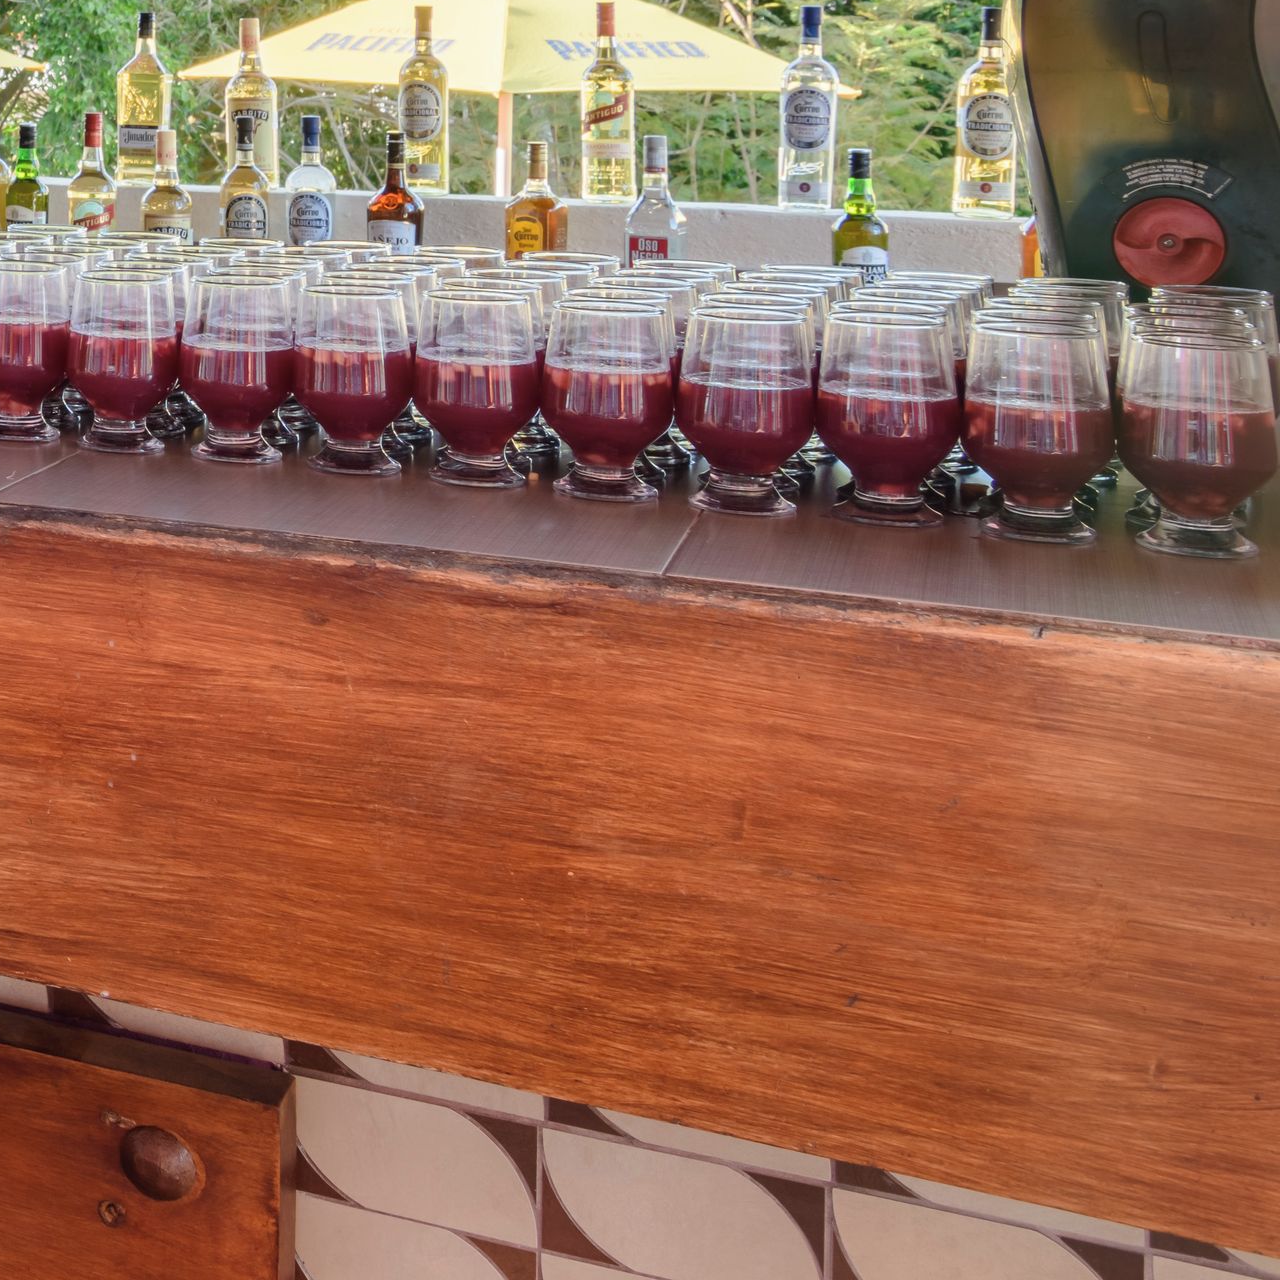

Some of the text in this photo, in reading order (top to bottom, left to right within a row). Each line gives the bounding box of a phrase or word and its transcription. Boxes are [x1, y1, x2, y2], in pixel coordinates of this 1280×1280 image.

[305, 32, 456, 53] PACIFIO
[544, 39, 706, 61] PAIFICO
[151, 227, 188, 240] ABRITO
[638, 239, 658, 251] OSO
